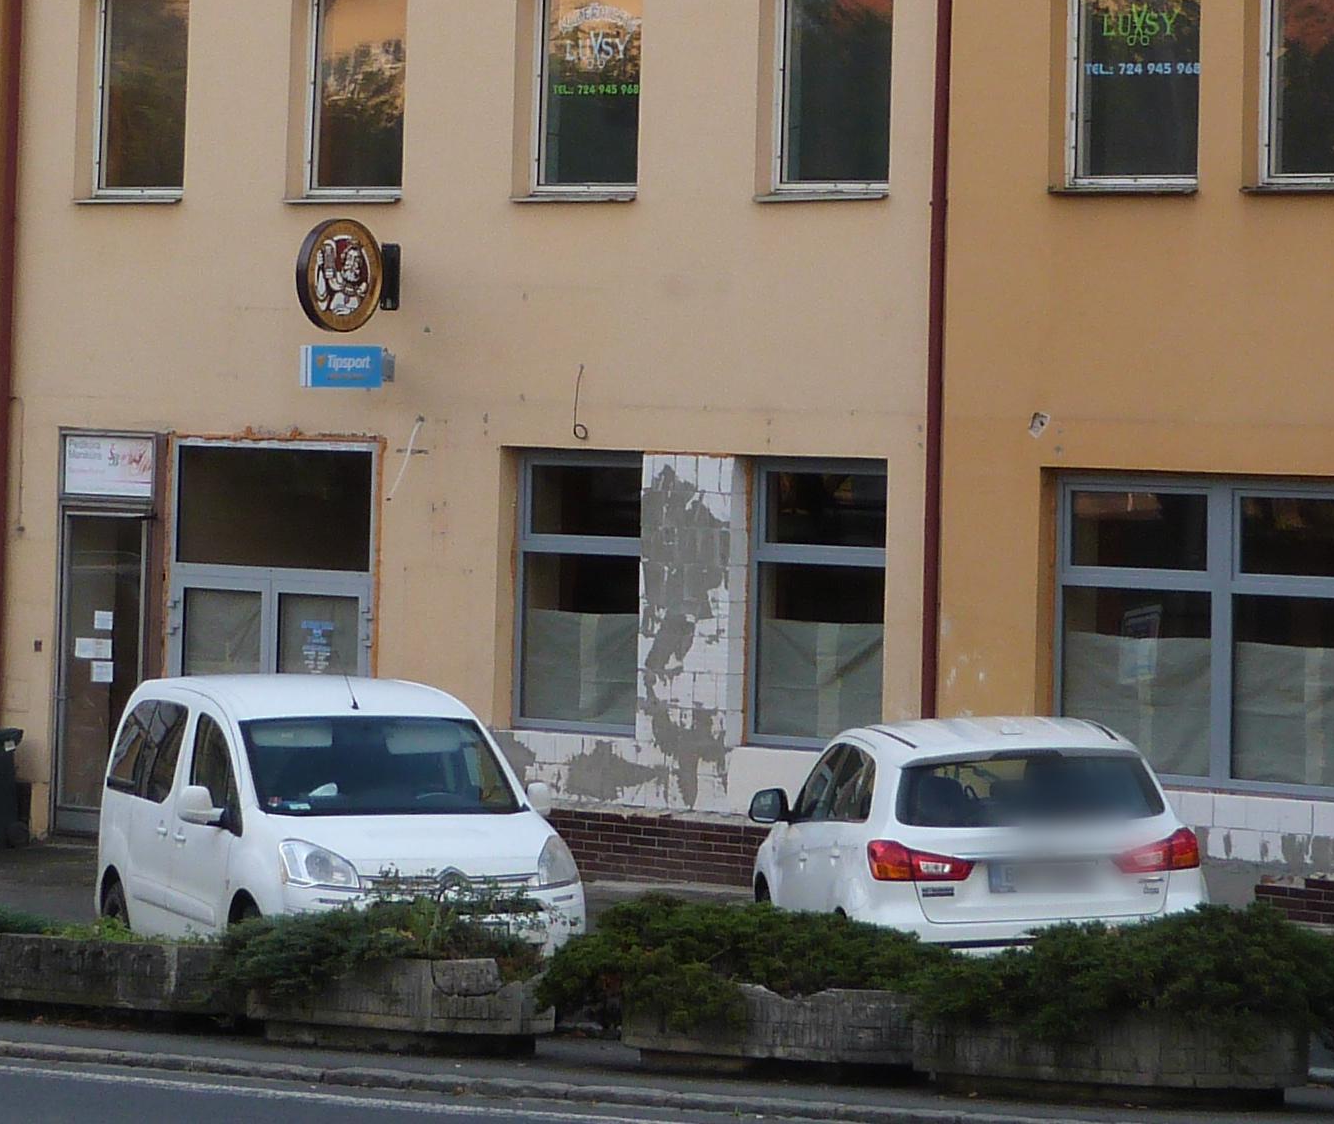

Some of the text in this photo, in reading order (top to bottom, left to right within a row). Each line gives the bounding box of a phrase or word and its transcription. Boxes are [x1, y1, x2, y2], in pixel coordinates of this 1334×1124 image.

[1118, 63, 1143, 75] 724
[1147, 63, 1172, 75] 945
[1177, 63, 1201, 75] 968
[578, 84, 595, 95] 724
[599, 84, 618, 95] 945
[621, 84, 639, 95] 968
[327, 354, 371, 372] Tipsport
